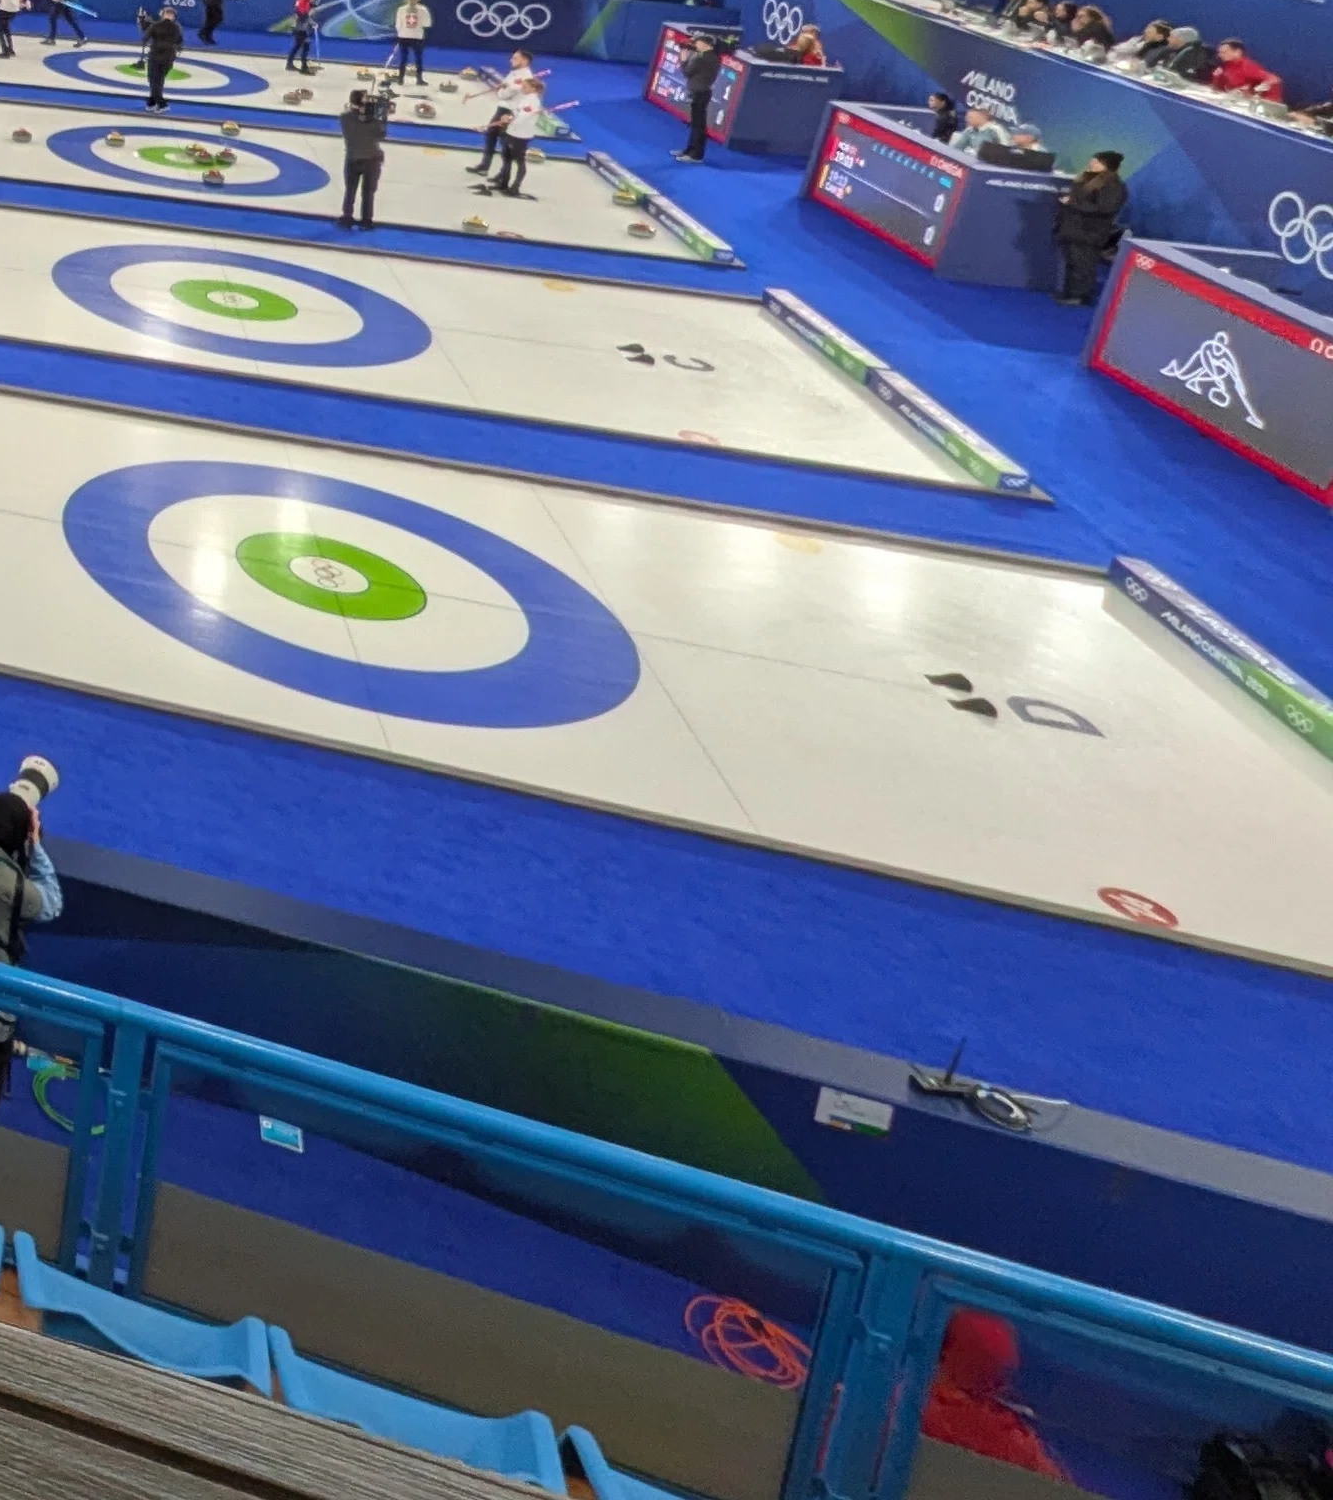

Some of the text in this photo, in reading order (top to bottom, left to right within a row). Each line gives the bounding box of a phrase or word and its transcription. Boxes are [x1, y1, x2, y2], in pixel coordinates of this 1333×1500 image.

[960, 70, 1016, 102] MILANO
[966, 90, 1018, 125] CORTINA
[1161, 611, 1201, 645] MILANO
[1200, 641, 1245, 681] CORTINA
[1006, 695, 1107, 740] D
